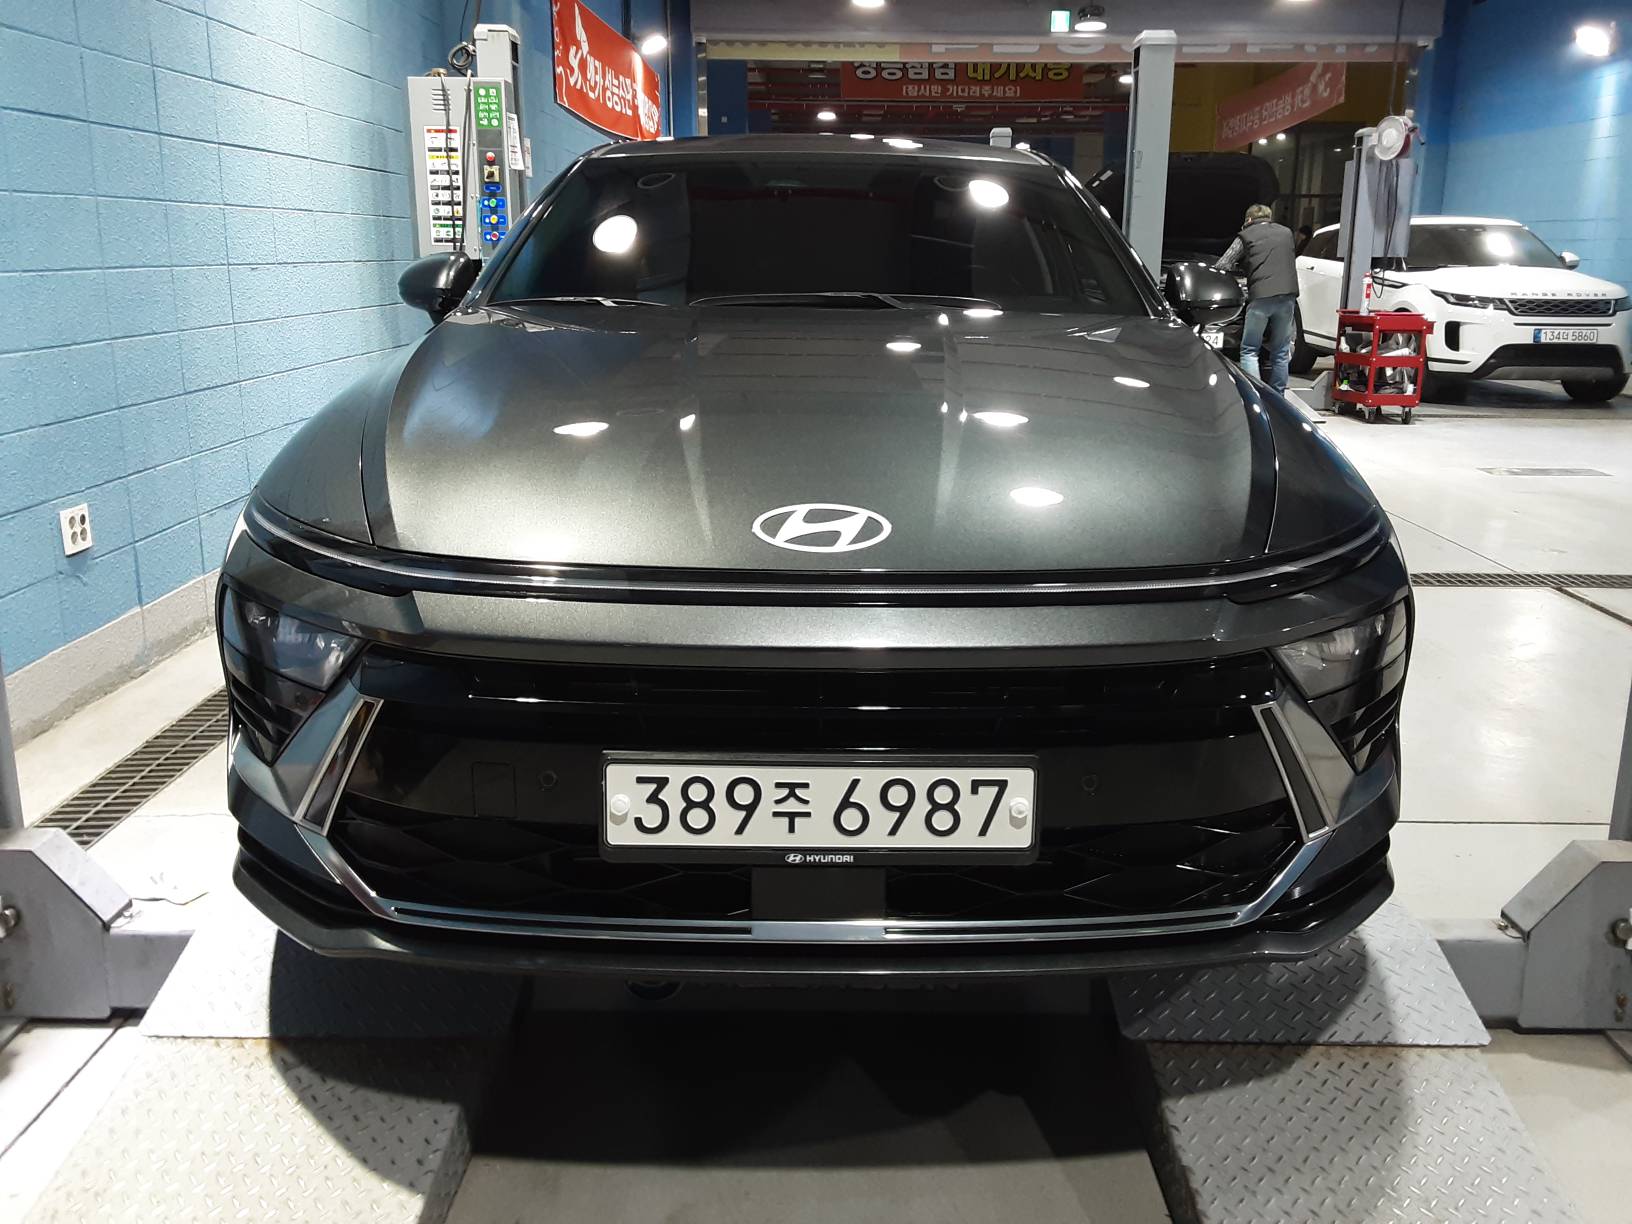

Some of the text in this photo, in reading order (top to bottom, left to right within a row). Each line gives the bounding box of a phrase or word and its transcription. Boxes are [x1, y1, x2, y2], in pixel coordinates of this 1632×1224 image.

[1571, 330, 1595, 341] 5860
[633, 776, 1009, 837] 389주 6987
[806, 854, 854, 863] HYUNDAI
